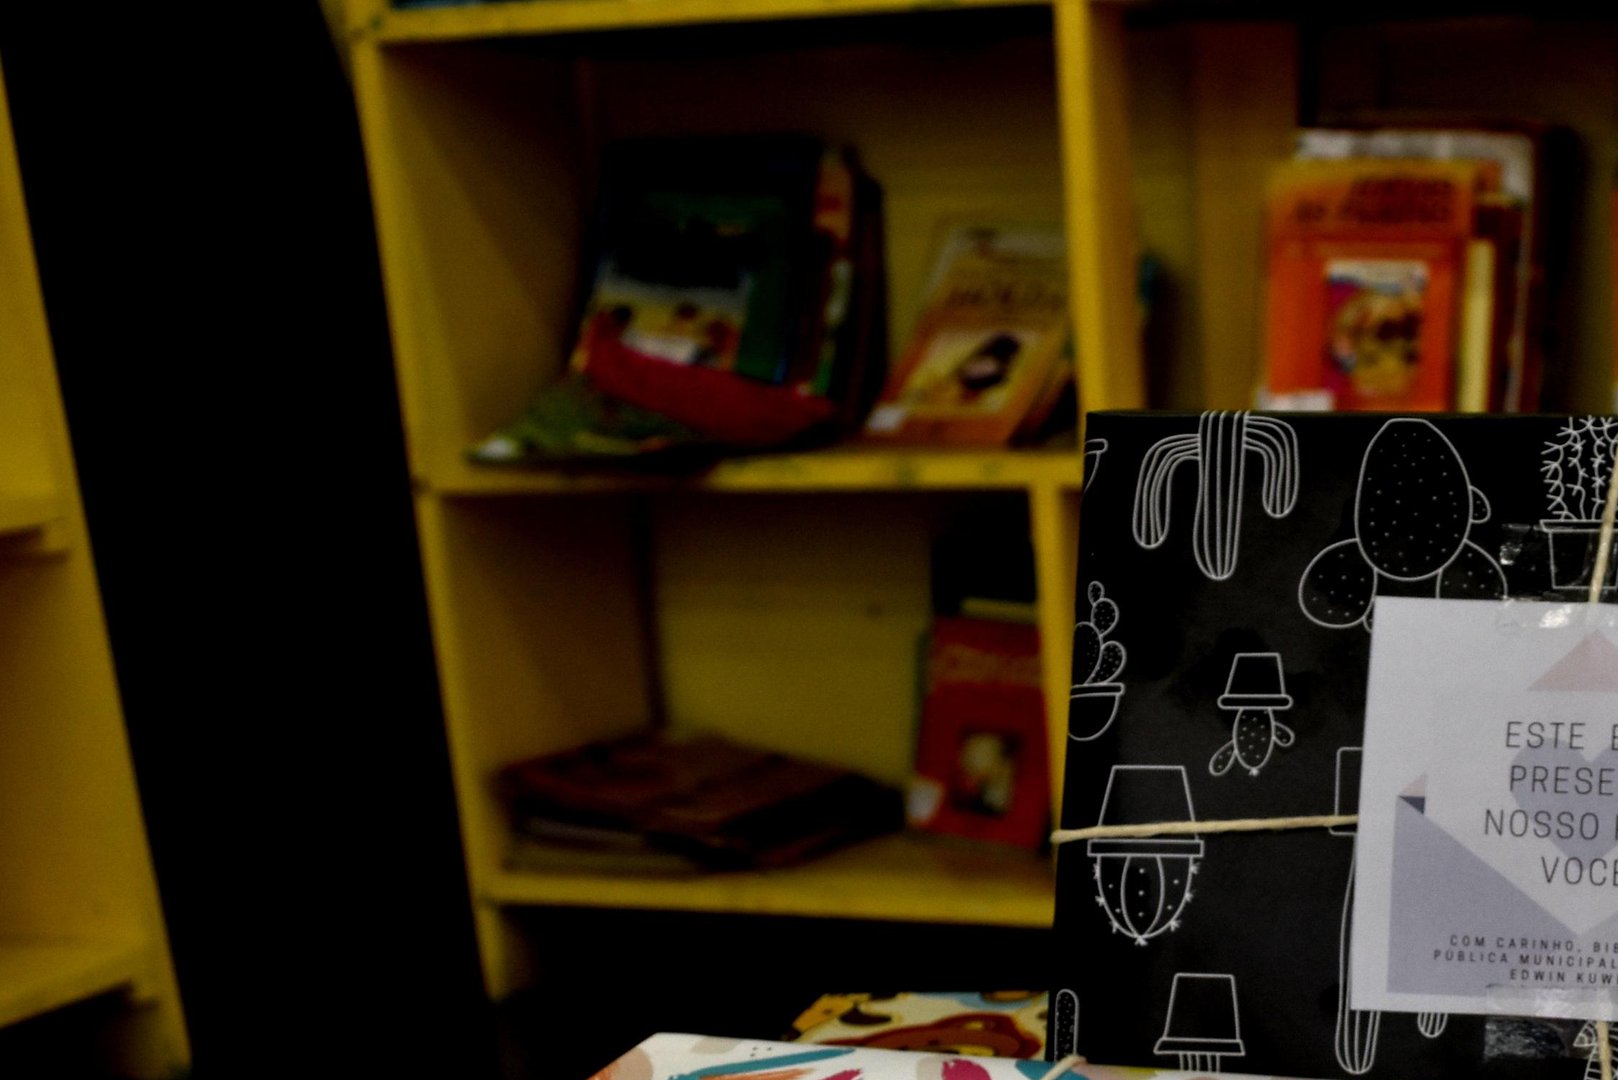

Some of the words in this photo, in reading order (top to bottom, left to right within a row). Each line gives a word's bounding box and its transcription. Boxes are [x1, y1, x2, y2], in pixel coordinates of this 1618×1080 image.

[1505, 721, 1586, 750] ESTE
[1484, 809, 1599, 841] NOSSO
[1449, 934, 1486, 948] COM
[1520, 953, 1617, 970] MUNICIPAL
[1510, 968, 1566, 983] EDWIN
